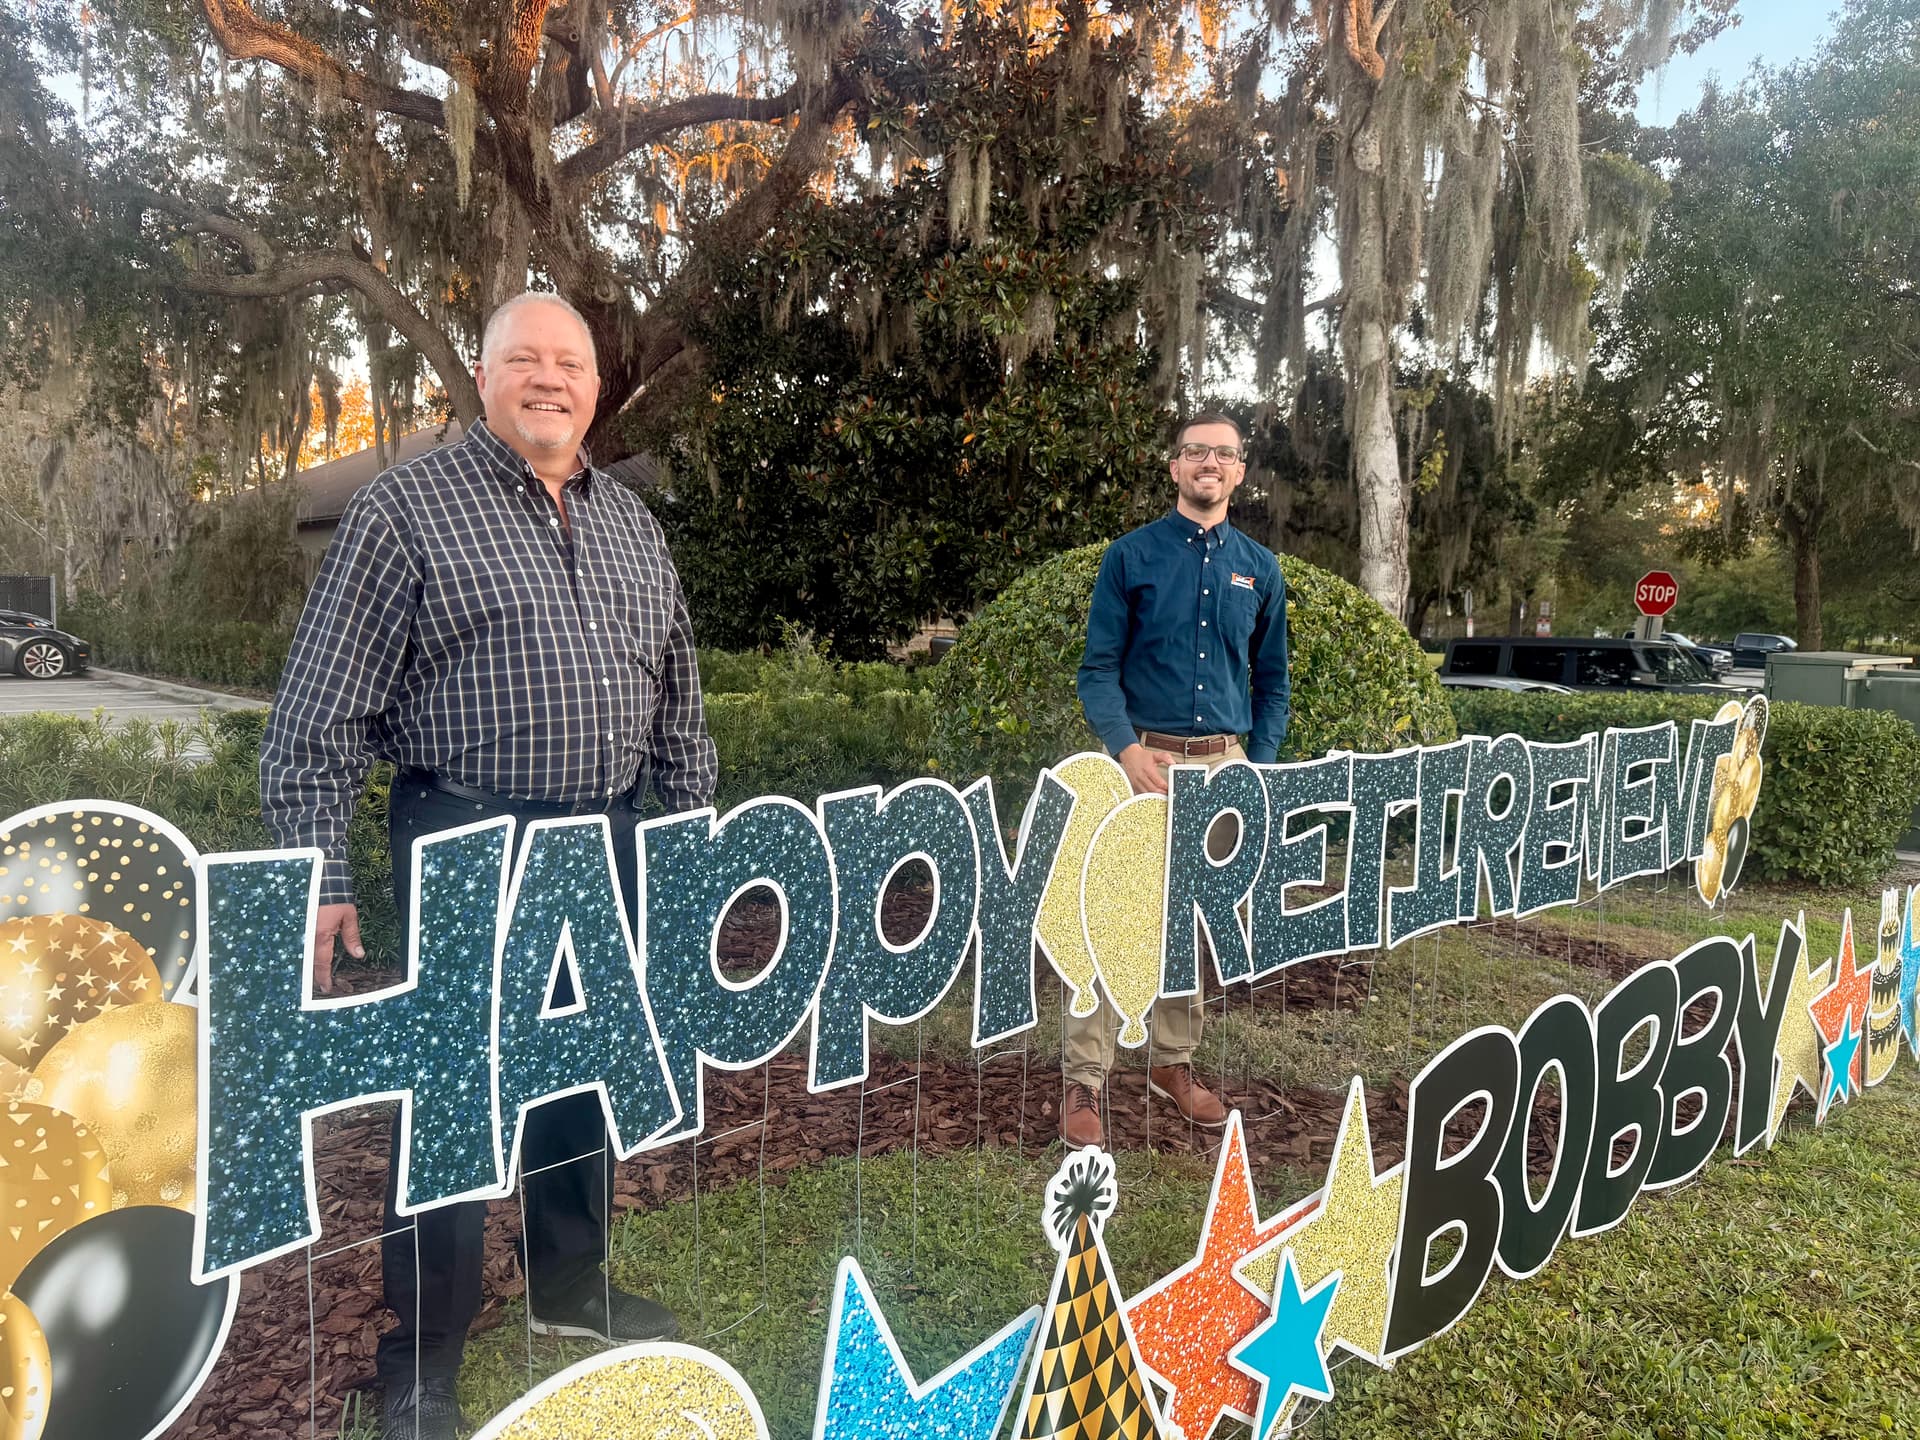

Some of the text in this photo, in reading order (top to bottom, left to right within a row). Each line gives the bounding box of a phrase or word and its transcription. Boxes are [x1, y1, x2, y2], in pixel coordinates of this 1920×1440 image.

[1638, 584, 1676, 603] STOP
[191, 716, 1740, 1284] HAPPY RETIREMENT
[1381, 920, 1801, 1359] BOBBY
